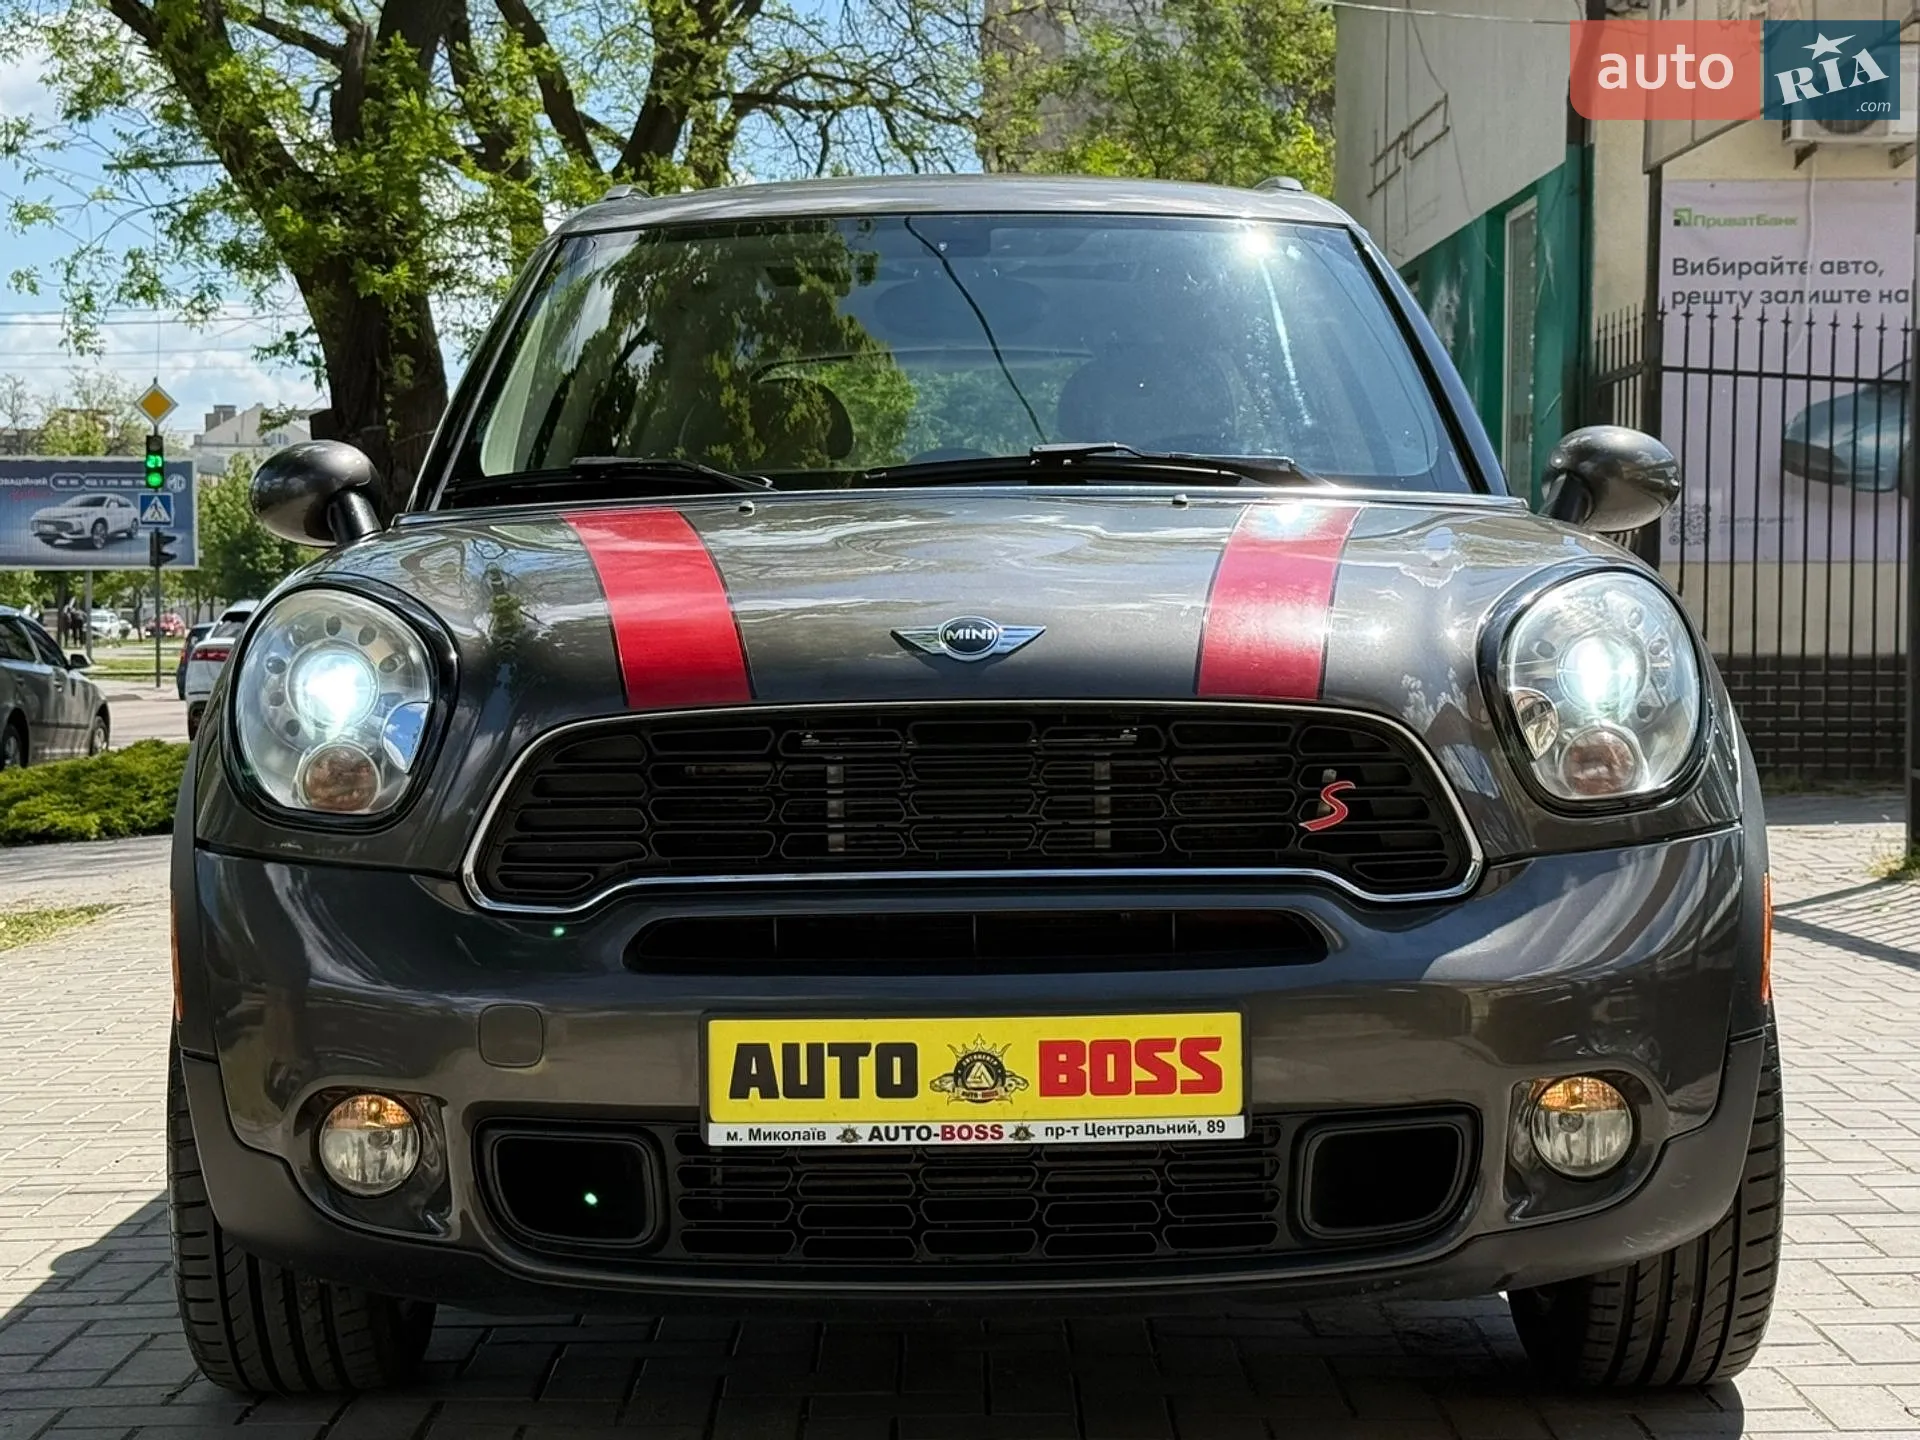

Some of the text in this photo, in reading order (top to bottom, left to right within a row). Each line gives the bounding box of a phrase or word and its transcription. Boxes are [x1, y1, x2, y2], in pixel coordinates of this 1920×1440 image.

[1693, 213, 1798, 229] ПриватБанк
[1672, 255, 1884, 280] Вибирайте авто,
[1672, 289, 1909, 310] решту залиште на
[945, 628, 994, 641] MINI
[1299, 780, 1356, 832] S
[729, 1036, 1223, 1099] AUTO BOSS
[726, 1119, 1225, 1142] м. Миколаїв AUTO-BOSS пр-т Центральний, 89
